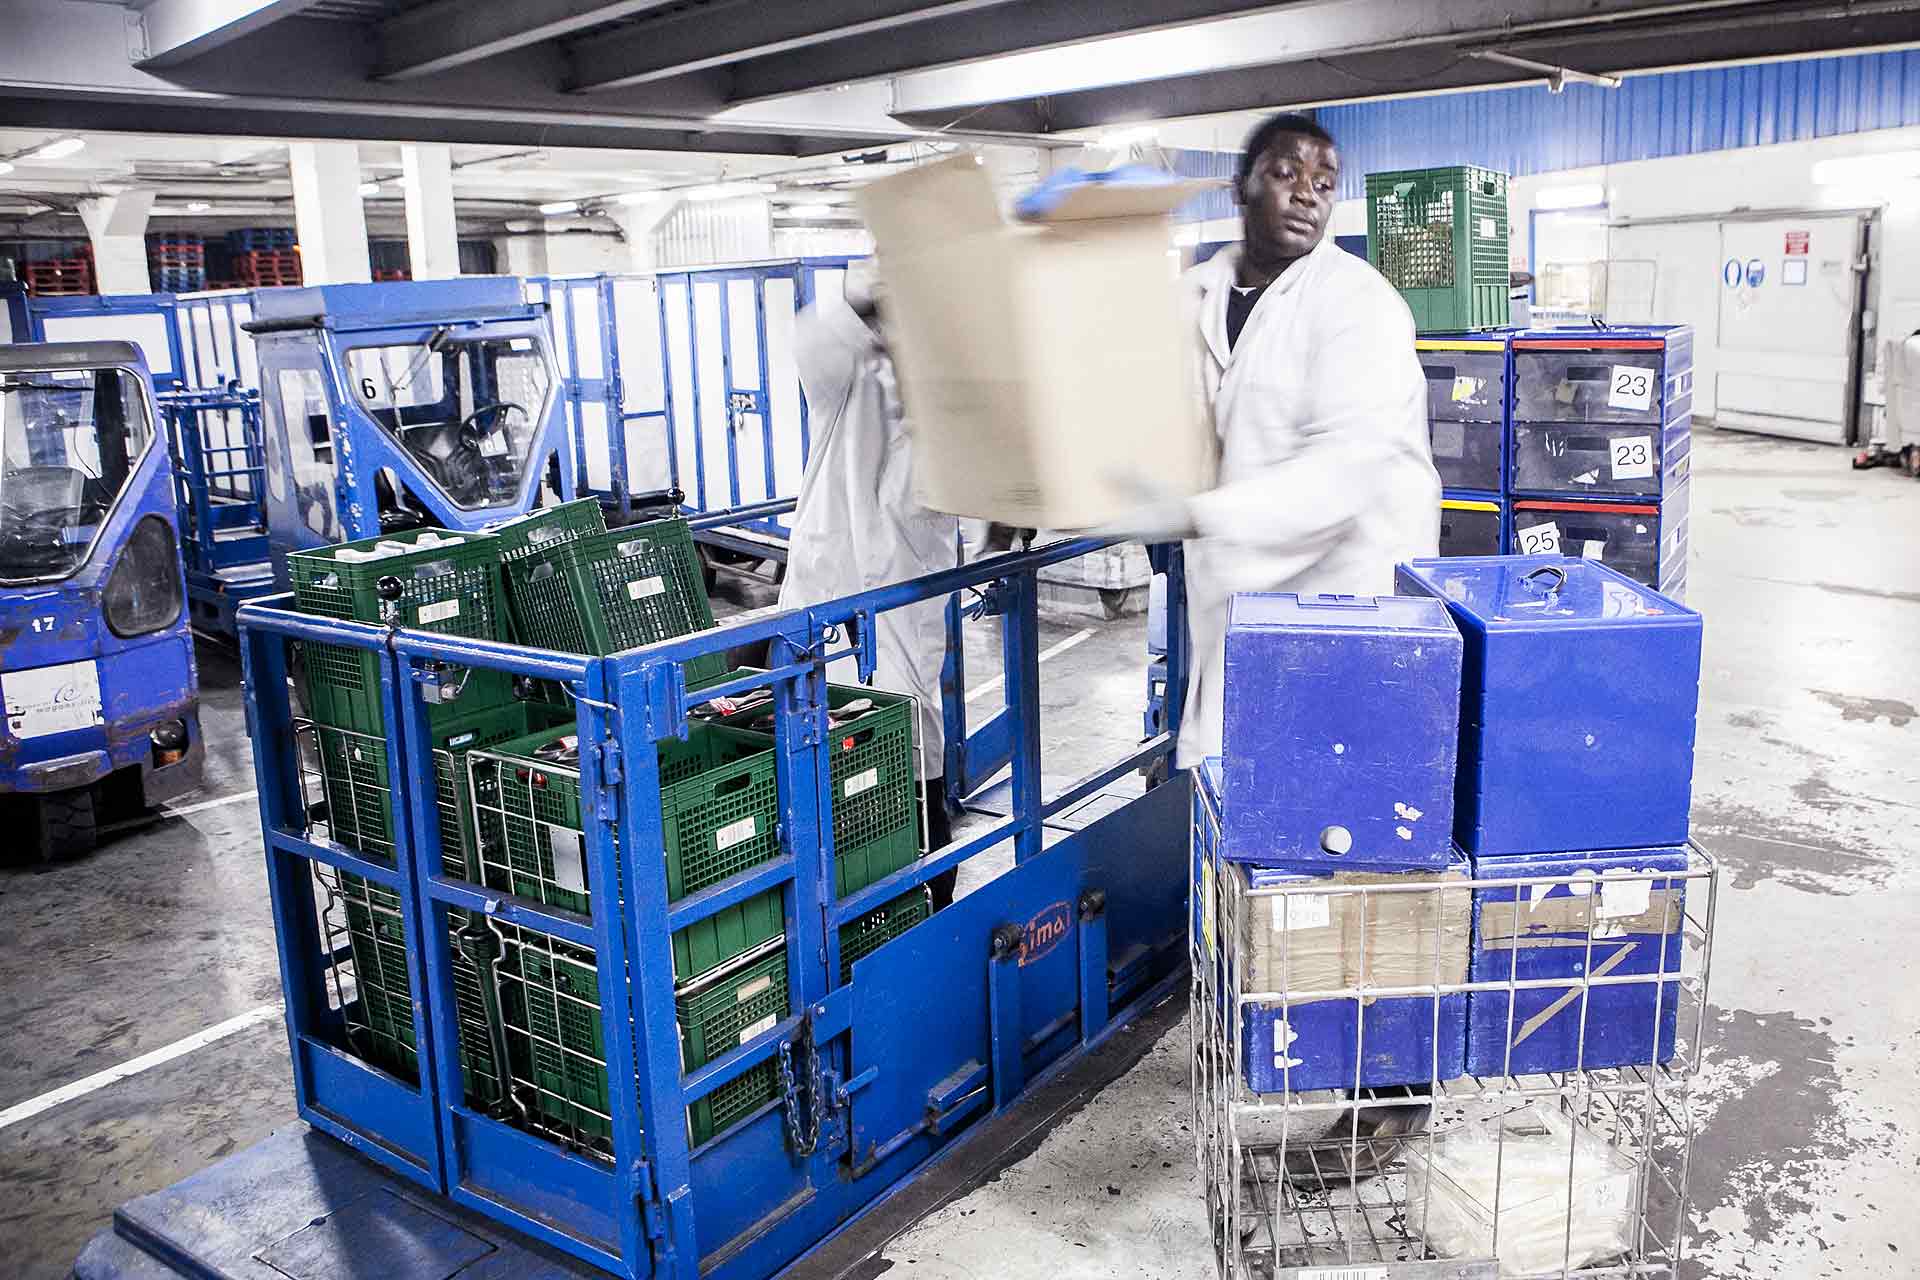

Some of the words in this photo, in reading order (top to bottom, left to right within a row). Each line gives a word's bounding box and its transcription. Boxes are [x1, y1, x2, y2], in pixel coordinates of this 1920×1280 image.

[361, 377, 377, 400] 6
[1616, 374, 1647, 397] 23
[1617, 444, 1647, 466] 23
[1526, 530, 1554, 554] 25
[32, 616, 55, 633] 17
